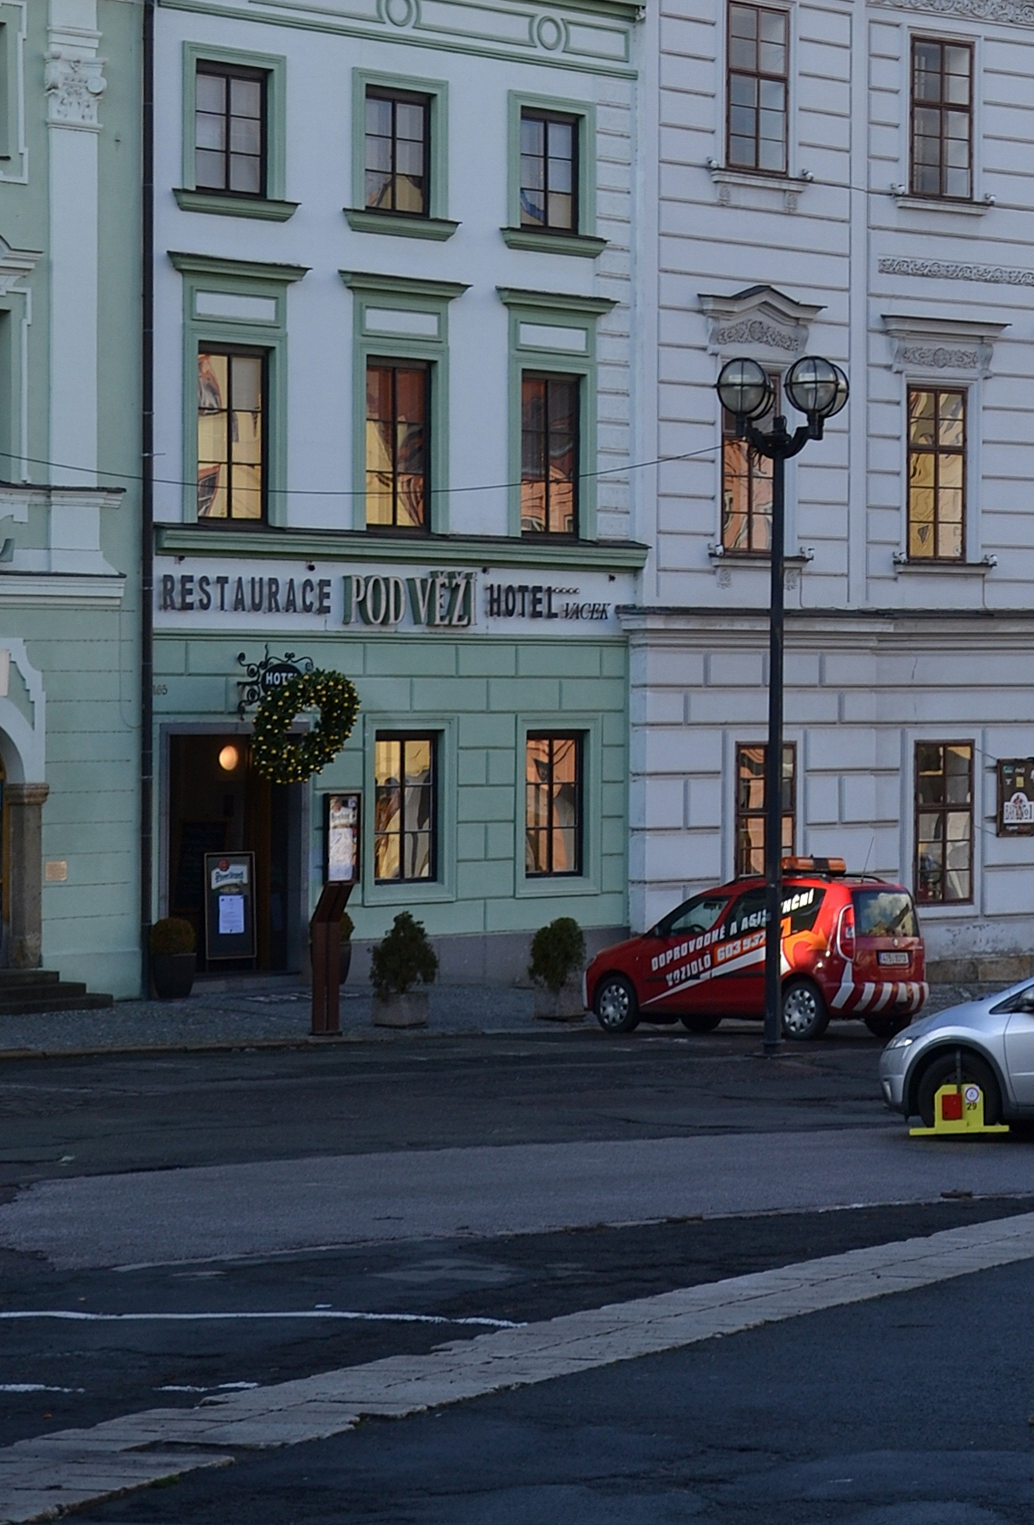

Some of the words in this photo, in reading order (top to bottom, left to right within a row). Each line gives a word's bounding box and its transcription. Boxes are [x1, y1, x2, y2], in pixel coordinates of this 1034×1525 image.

[162, 575, 332, 614] RESTAURACE
[342, 575, 406, 625] POD
[406, 570, 478, 627] VĚŽÍ
[487, 584, 558, 618] HOTEL
[564, 602, 611, 620] VACEK
[265, 672, 297, 685] HOT
[651, 923, 726, 972] DOPROVODNÉ
[729, 922, 737, 936] A
[665, 954, 712, 987] VOZIDLO
[717, 940, 741, 961] 603
[966, 1102, 977, 1110] 29
